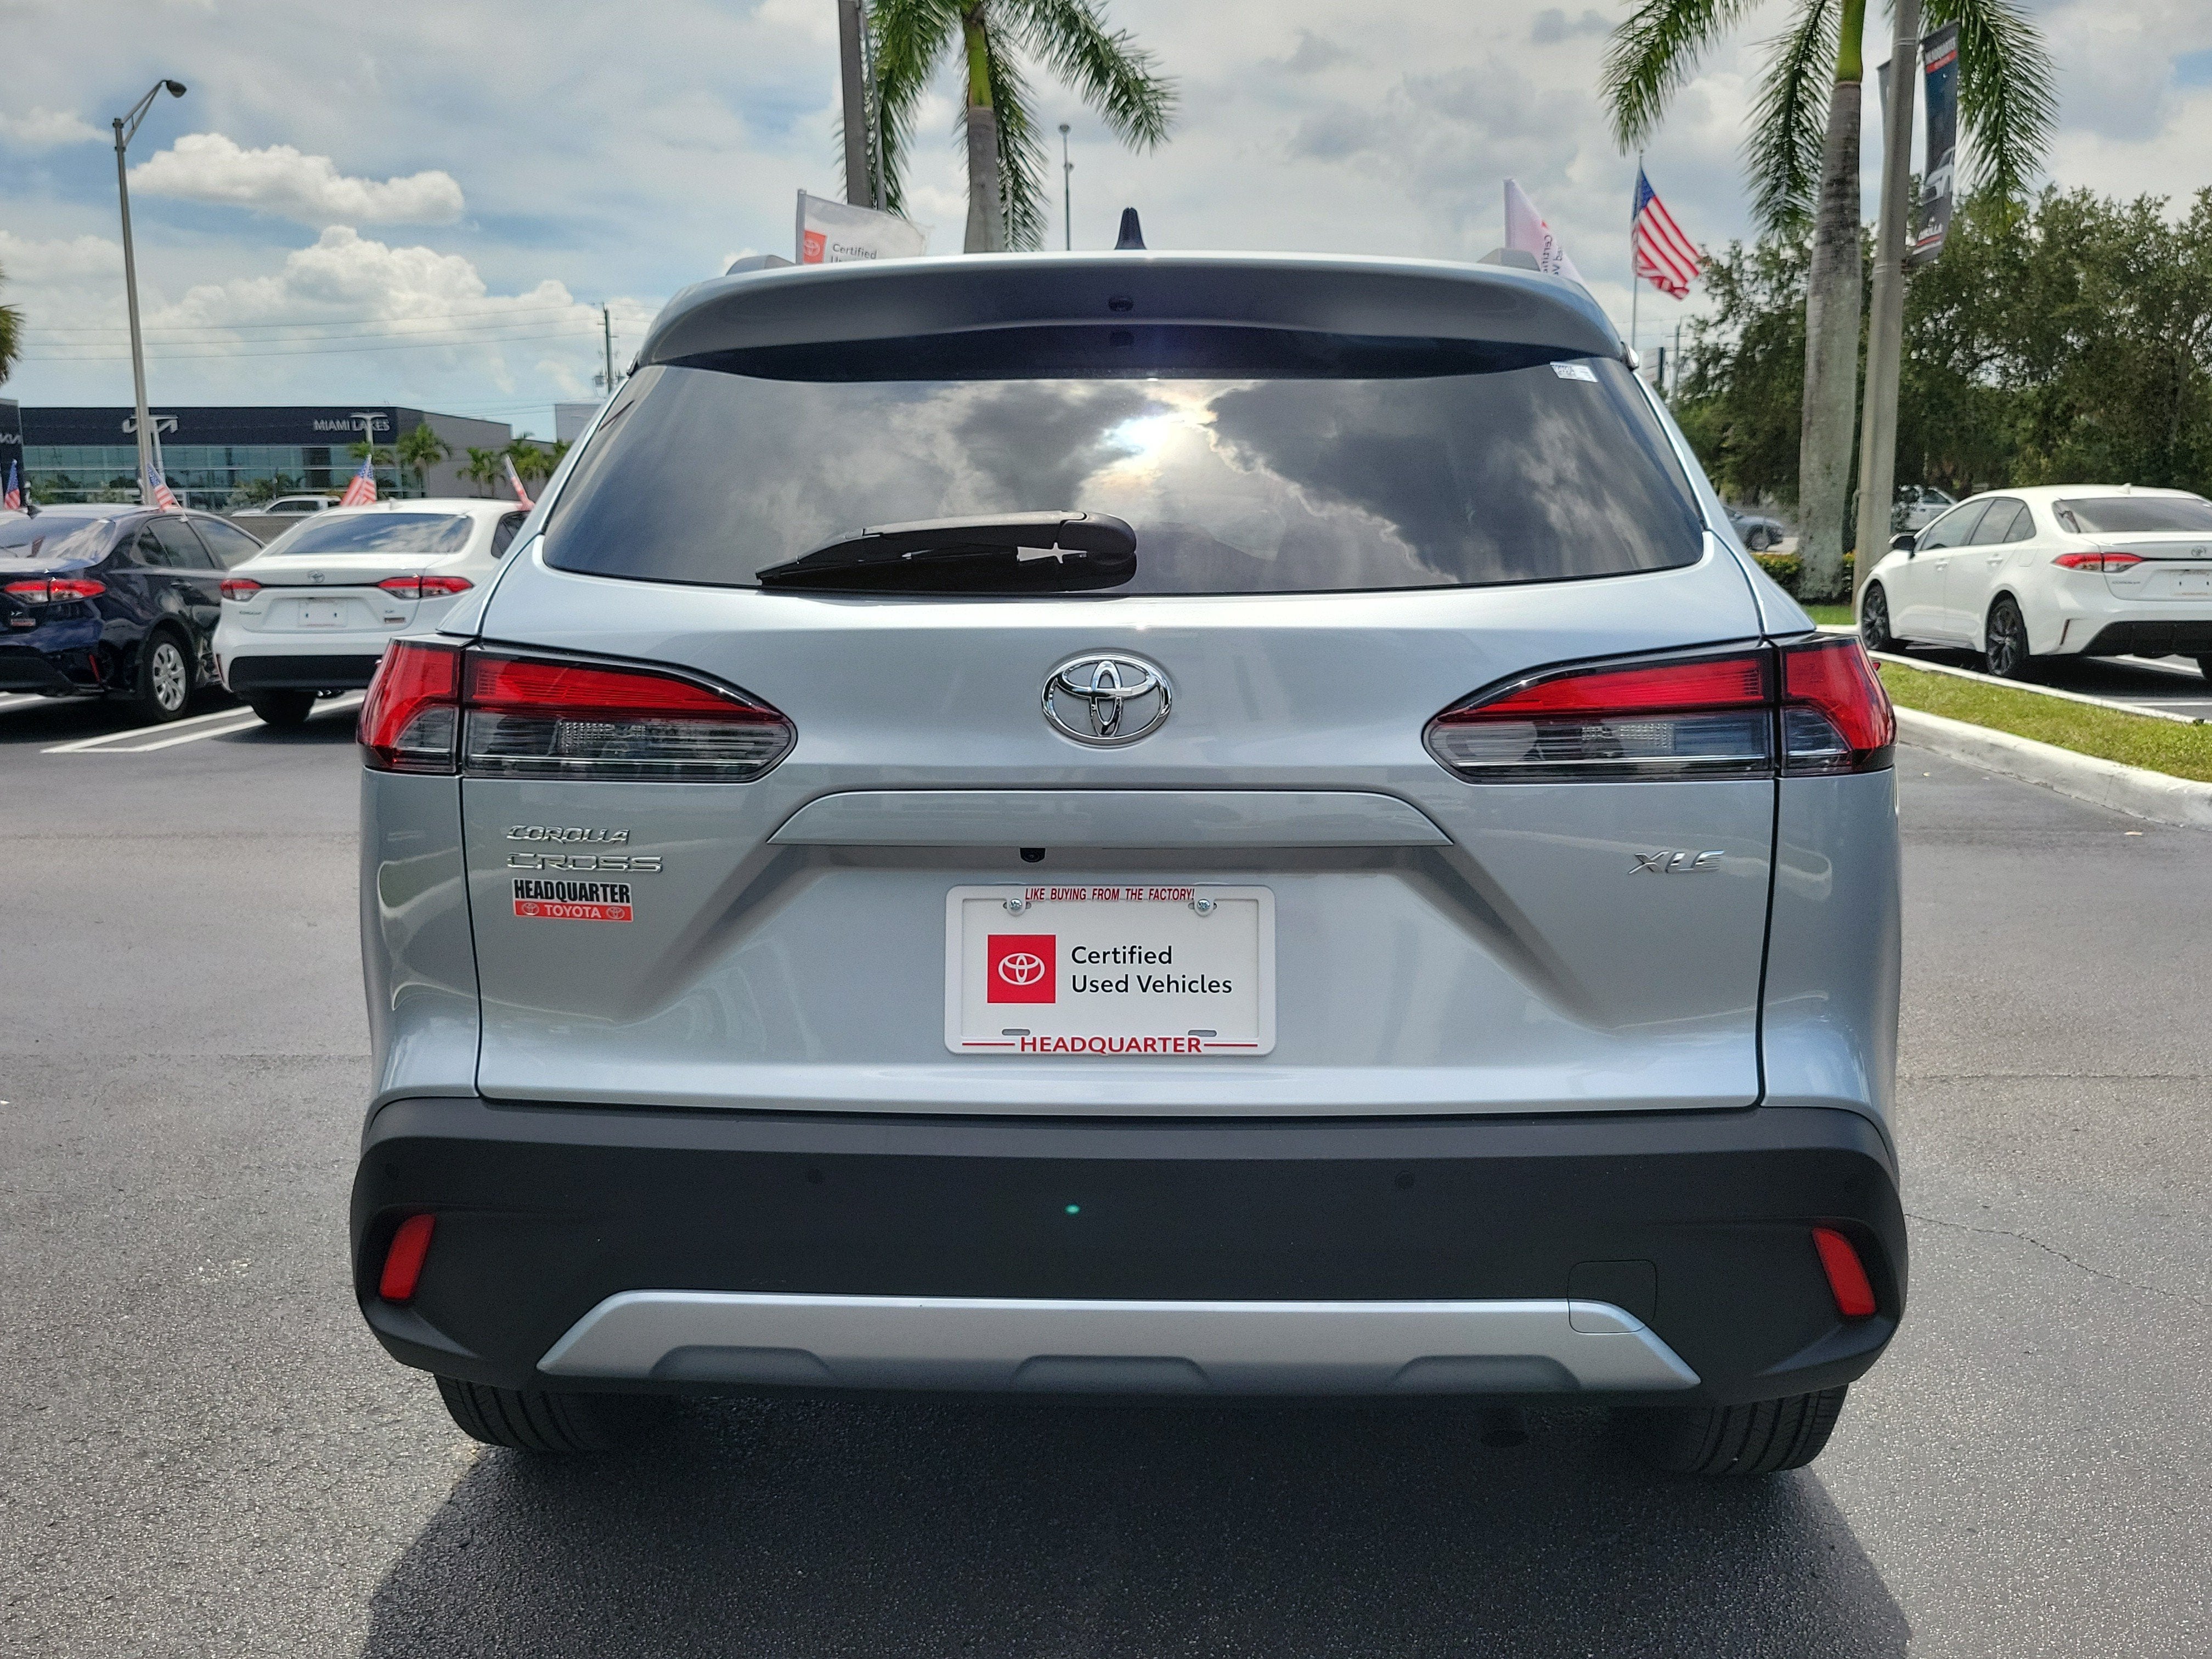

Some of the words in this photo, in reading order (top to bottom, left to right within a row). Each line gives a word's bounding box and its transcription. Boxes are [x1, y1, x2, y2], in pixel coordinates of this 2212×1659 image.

[832, 244, 878, 259] Certified
[313, 419, 350, 431] MIAMI
[506, 825, 630, 845] COROLLA
[506, 852, 663, 872] CROSS
[1627, 850, 1724, 876] XLE
[514, 879, 631, 904] HEADQUARTER
[1025, 888, 1046, 900] LIKE
[1050, 888, 1087, 901] BUYING
[1092, 888, 1120, 901] FROM
[1125, 888, 1143, 901] THE
[1148, 888, 1195, 901] FACTORY!
[544, 904, 602, 919] TOYOTA
[1071, 945, 1172, 964] Certified
[1071, 974, 1129, 993] Used
[1136, 974, 1233, 994] Vehicles
[1020, 1036, 1202, 1054] HEADQUARTER
